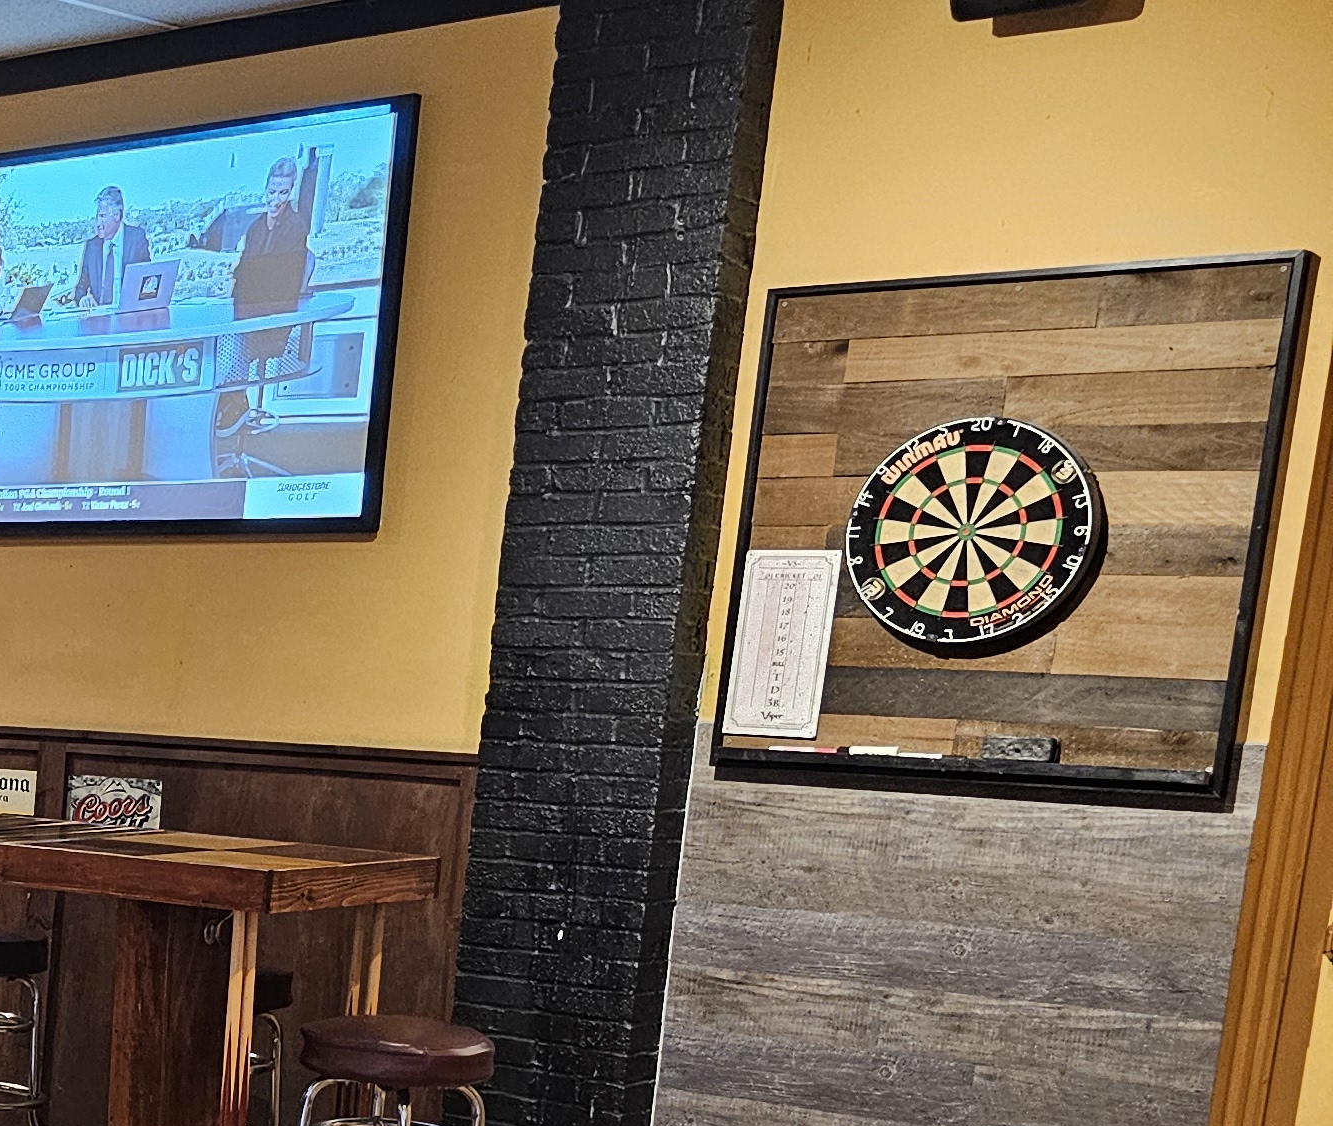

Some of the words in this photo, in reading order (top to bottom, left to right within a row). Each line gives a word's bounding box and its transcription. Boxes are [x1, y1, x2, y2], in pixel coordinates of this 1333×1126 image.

[4, 363, 36, 380] CME
[39, 362, 96, 379] GROUP
[120, 348, 200, 389] DICK'S
[4, 383, 26, 392] TOUR
[28, 382, 95, 391] CHAMPIONSHIP
[970, 419, 993, 432] 20
[1037, 437, 1056, 454] 18
[880, 430, 961, 485] WINMAU
[1062, 554, 1083, 571] 10
[969, 574, 1054, 627] DIAMOND
[779, 622, 789, 630] 17
[771, 686, 780, 694] D
[72, 793, 153, 823] Coors
